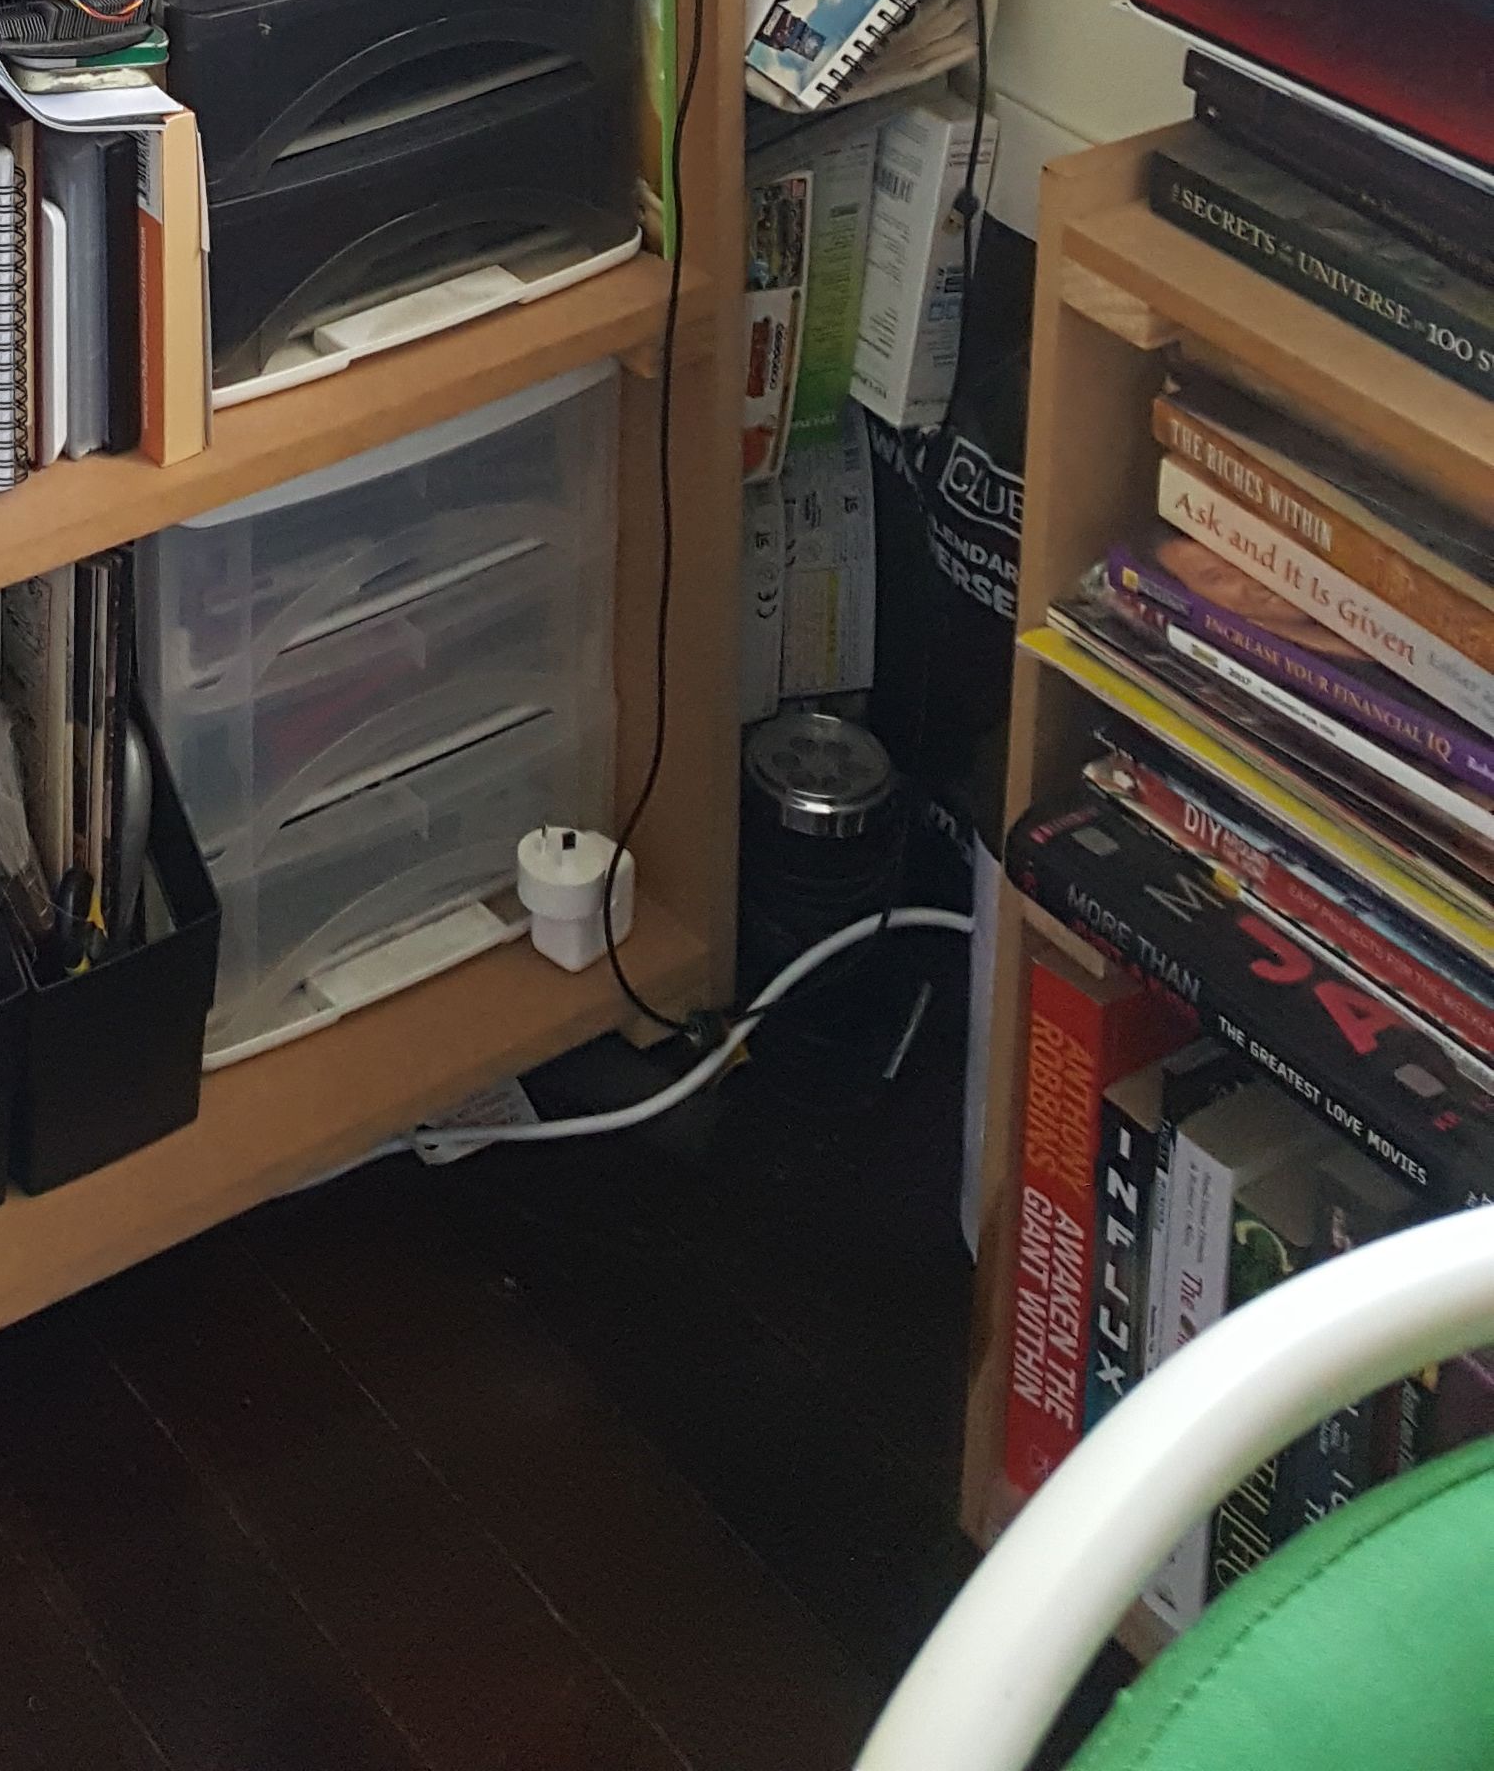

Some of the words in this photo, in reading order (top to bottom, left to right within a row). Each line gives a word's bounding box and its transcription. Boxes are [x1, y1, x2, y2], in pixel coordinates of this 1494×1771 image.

[1180, 189, 1277, 256] SECRETS
[1298, 251, 1412, 330] UNIVERSE
[1426, 323, 1474, 361] 100
[1169, 419, 1205, 462] THE
[1207, 436, 1264, 505] RICHES
[1267, 475, 1334, 552] WITHIN
[1174, 491, 1221, 537] Ask
[1229, 521, 1278, 570] and
[1286, 555, 1309, 590] It
[1311, 576, 1332, 611] Is
[1338, 589, 1420, 667] Given
[1205, 613, 1281, 665] INCREASE
[1283, 654, 1330, 693] YOUR
[1332, 680, 1423, 745] FINANCIAL
[1426, 730, 1453, 763] IQ
[1183, 803, 1222, 847] DIY
[1066, 883, 1131, 952] MORE
[1025, 1013, 1066, 1178] ROBBINS
[1217, 1013, 1246, 1050] THE
[1249, 1040, 1321, 1101] GREATEST
[1325, 1097, 1365, 1139] LOVE
[1367, 1129, 1429, 1187] MOVIES
[1020, 1185, 1054, 1280] GIANT
[1047, 1204, 1086, 1361] AWAKEN
[1013, 1282, 1047, 1410] WITHIN
[1043, 1364, 1080, 1432] THE
